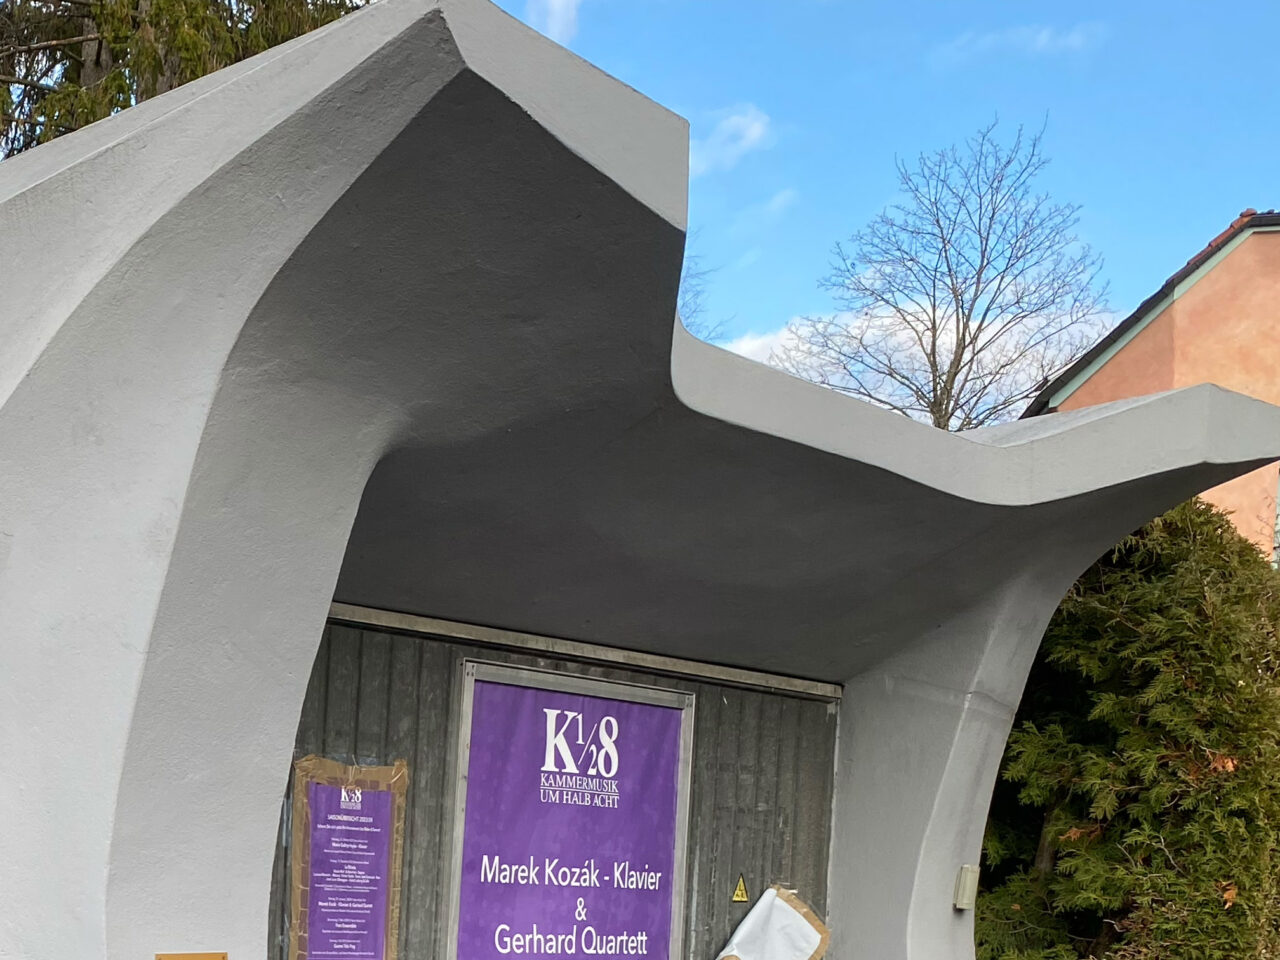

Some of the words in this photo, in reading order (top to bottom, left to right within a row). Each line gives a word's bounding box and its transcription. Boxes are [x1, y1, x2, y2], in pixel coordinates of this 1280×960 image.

[540, 772, 619, 792] KAMMERMUSIK
[540, 789, 559, 803] UM
[562, 792, 591, 806] HALB
[593, 794, 620, 808] ACHT
[481, 854, 539, 884] Marek
[545, 858, 600, 887] Kozák
[614, 862, 662, 890] Klavier
[575, 898, 586, 920] &
[495, 924, 576, 954] Gerhard
[581, 926, 648, 954] Quartett
